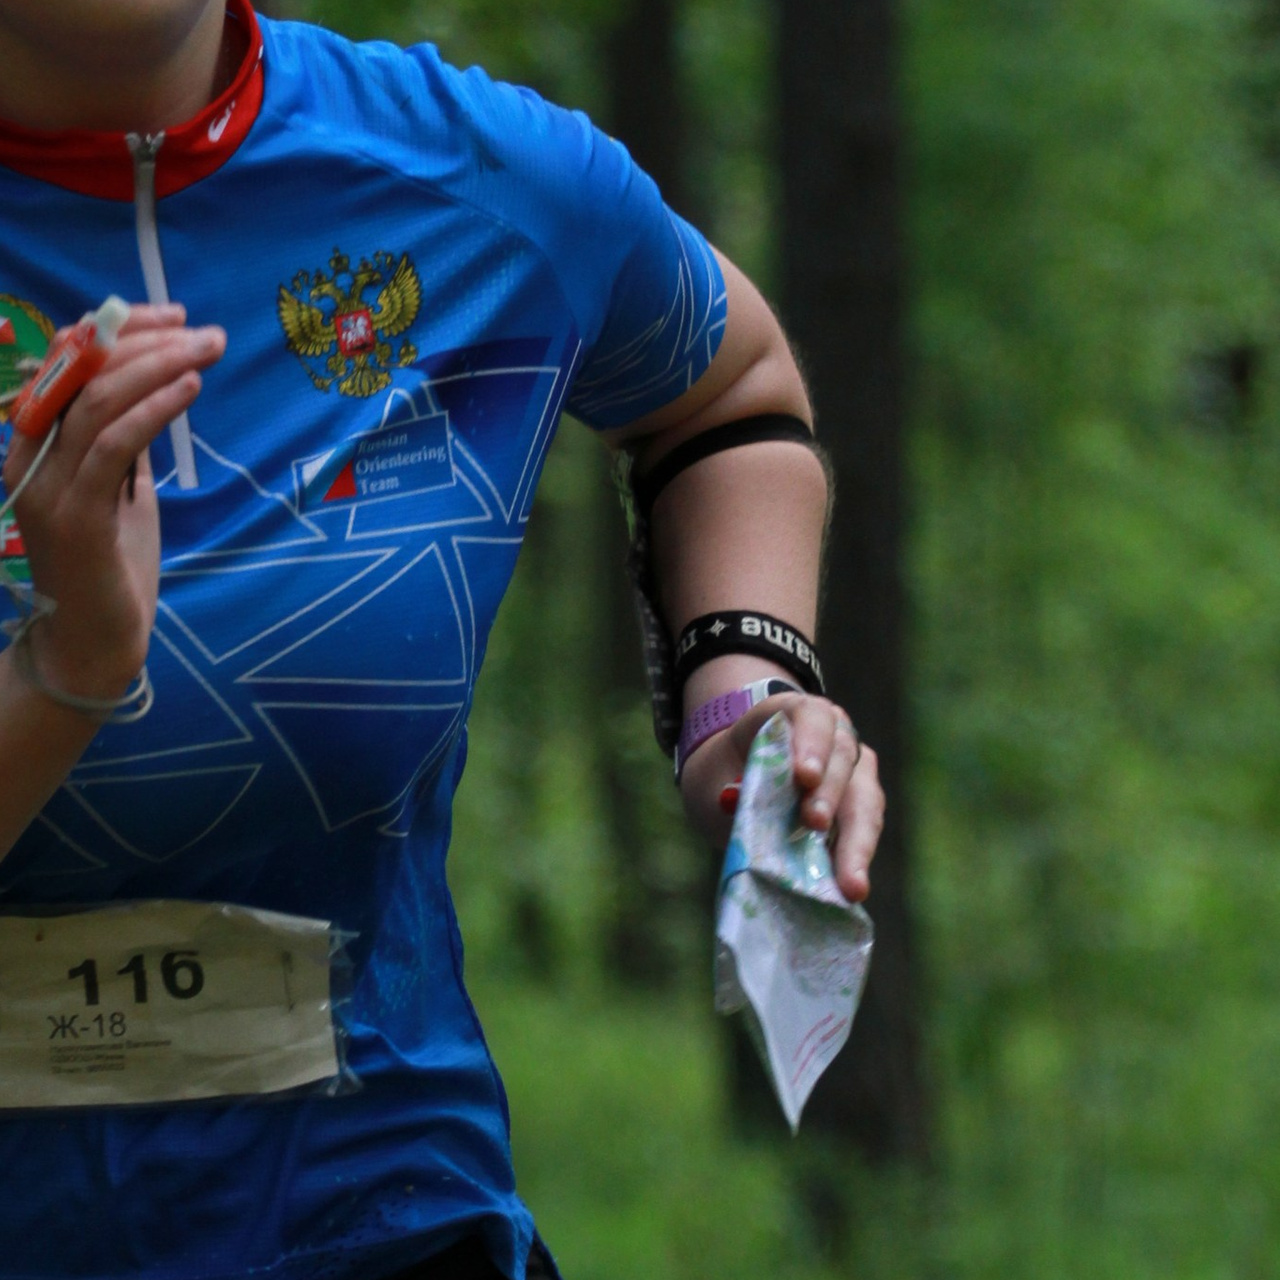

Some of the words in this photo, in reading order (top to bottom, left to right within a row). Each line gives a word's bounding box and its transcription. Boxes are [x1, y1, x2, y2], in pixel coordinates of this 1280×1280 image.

[355, 445, 447, 475] Orienteering
[357, 476, 400, 495] Team
[68, 949, 205, 1006] 116
[47, 1012, 127, 1040] Ж-18
